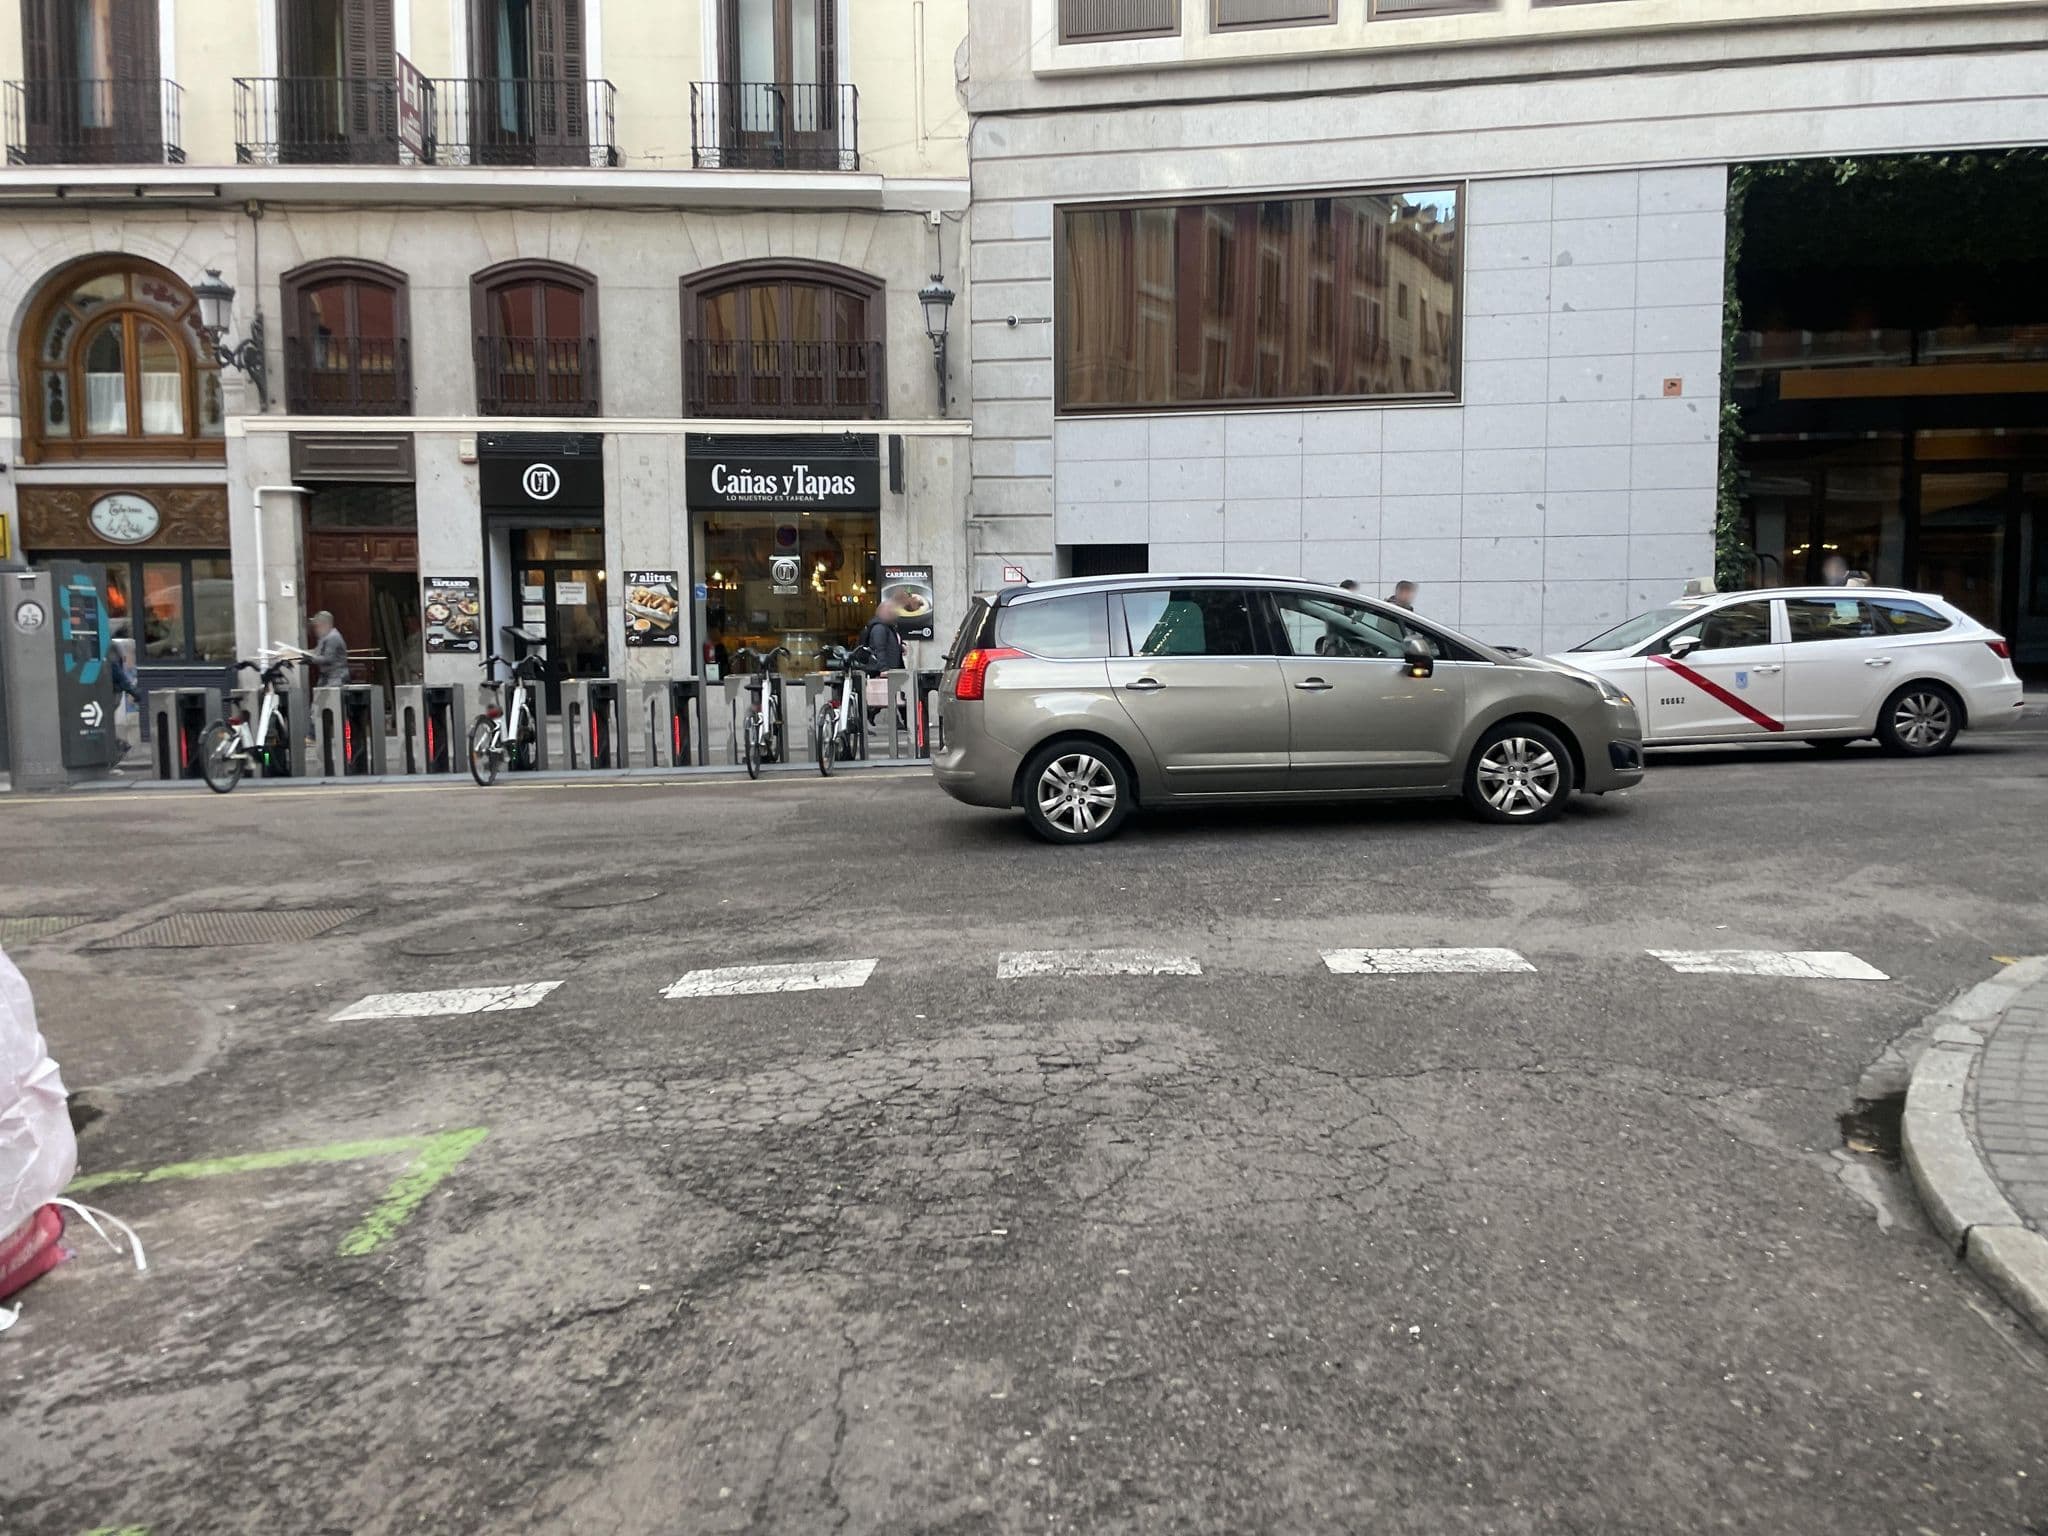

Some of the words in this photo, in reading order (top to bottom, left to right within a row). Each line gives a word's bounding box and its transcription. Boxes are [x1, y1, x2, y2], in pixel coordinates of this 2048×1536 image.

[402, 63, 419, 112] H
[711, 463, 778, 495] Cañas
[782, 475, 794, 495] y
[792, 464, 856, 500] Tapas
[726, 494, 737, 502] LO
[629, 573, 637, 583] 7
[638, 572, 672, 583] alitas
